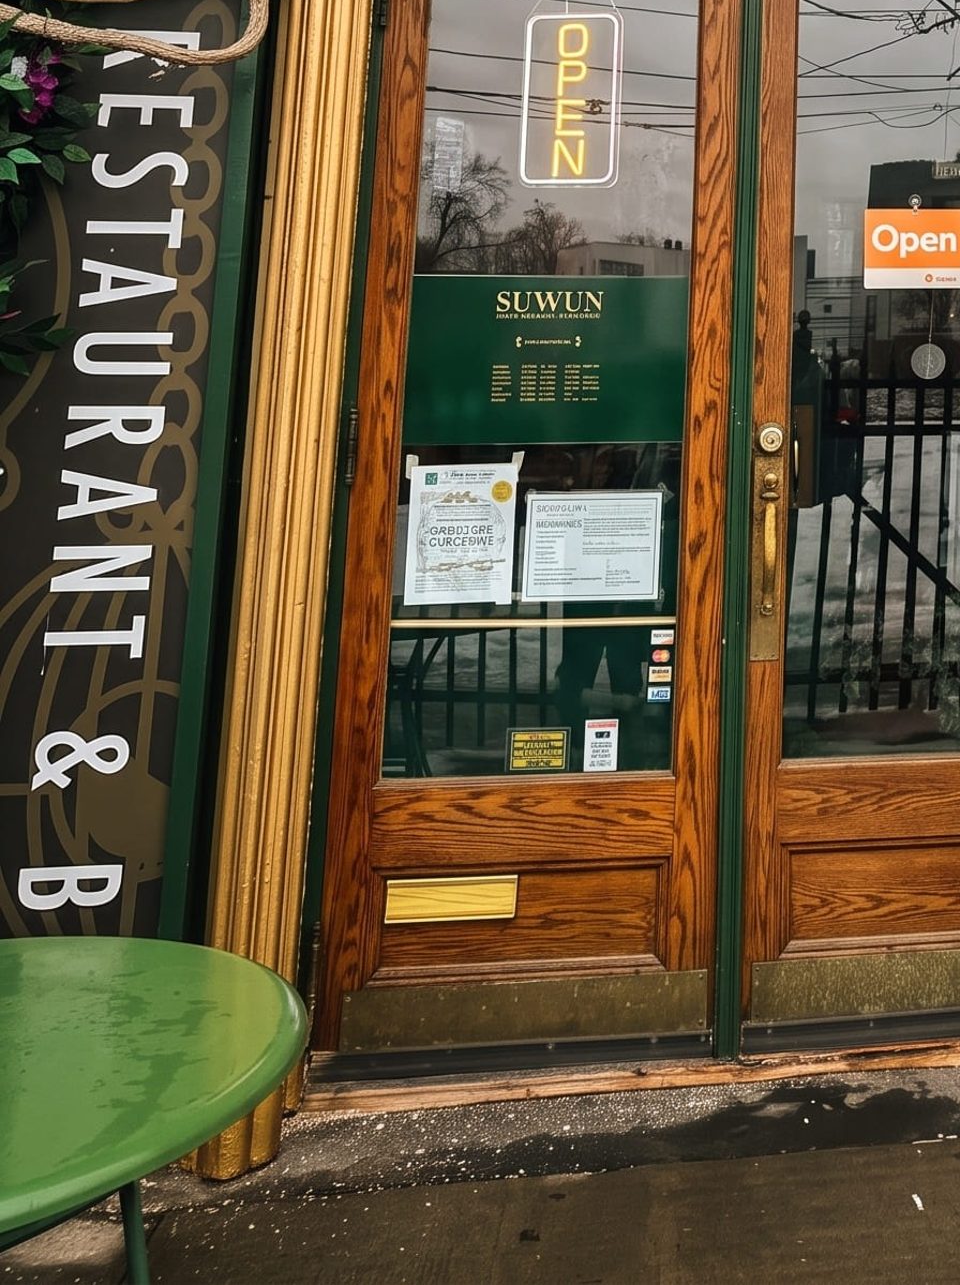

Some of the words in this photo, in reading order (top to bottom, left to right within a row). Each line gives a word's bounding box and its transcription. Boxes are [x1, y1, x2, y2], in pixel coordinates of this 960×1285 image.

[551, 23, 588, 177] OPEN
[871, 223, 957, 259] Open
[496, 290, 604, 313] SUWUN
[31, 730, 130, 791] &
